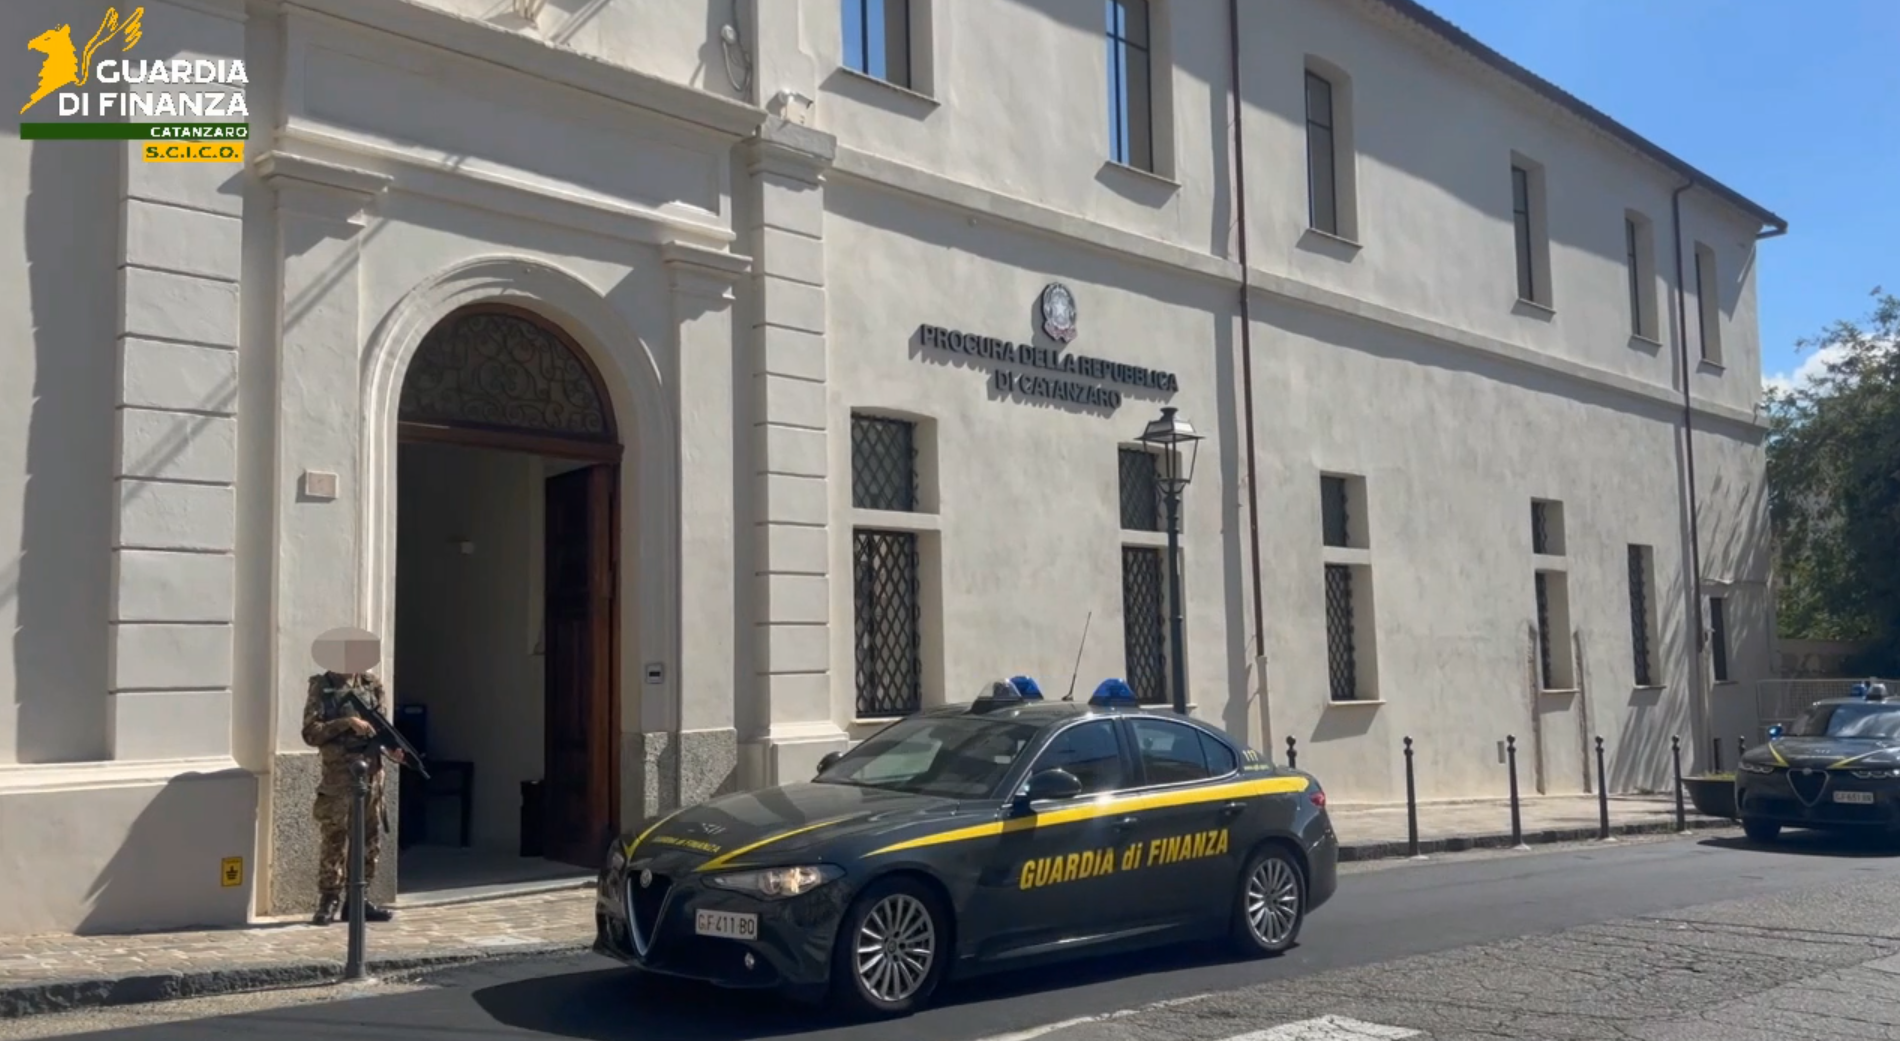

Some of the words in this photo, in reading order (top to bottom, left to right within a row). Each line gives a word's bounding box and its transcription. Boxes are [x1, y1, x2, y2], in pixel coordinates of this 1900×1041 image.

[920, 323, 1014, 364] PROCURA
[1018, 343, 1077, 373] DELLA
[1077, 355, 1179, 393] REPUBBLICA
[995, 368, 1015, 392] DI
[1017, 375, 1123, 409] CATANZARO
[1019, 847, 1114, 890] GUARDIA
[1121, 842, 1143, 872] di
[1147, 828, 1229, 866] FINANZA
